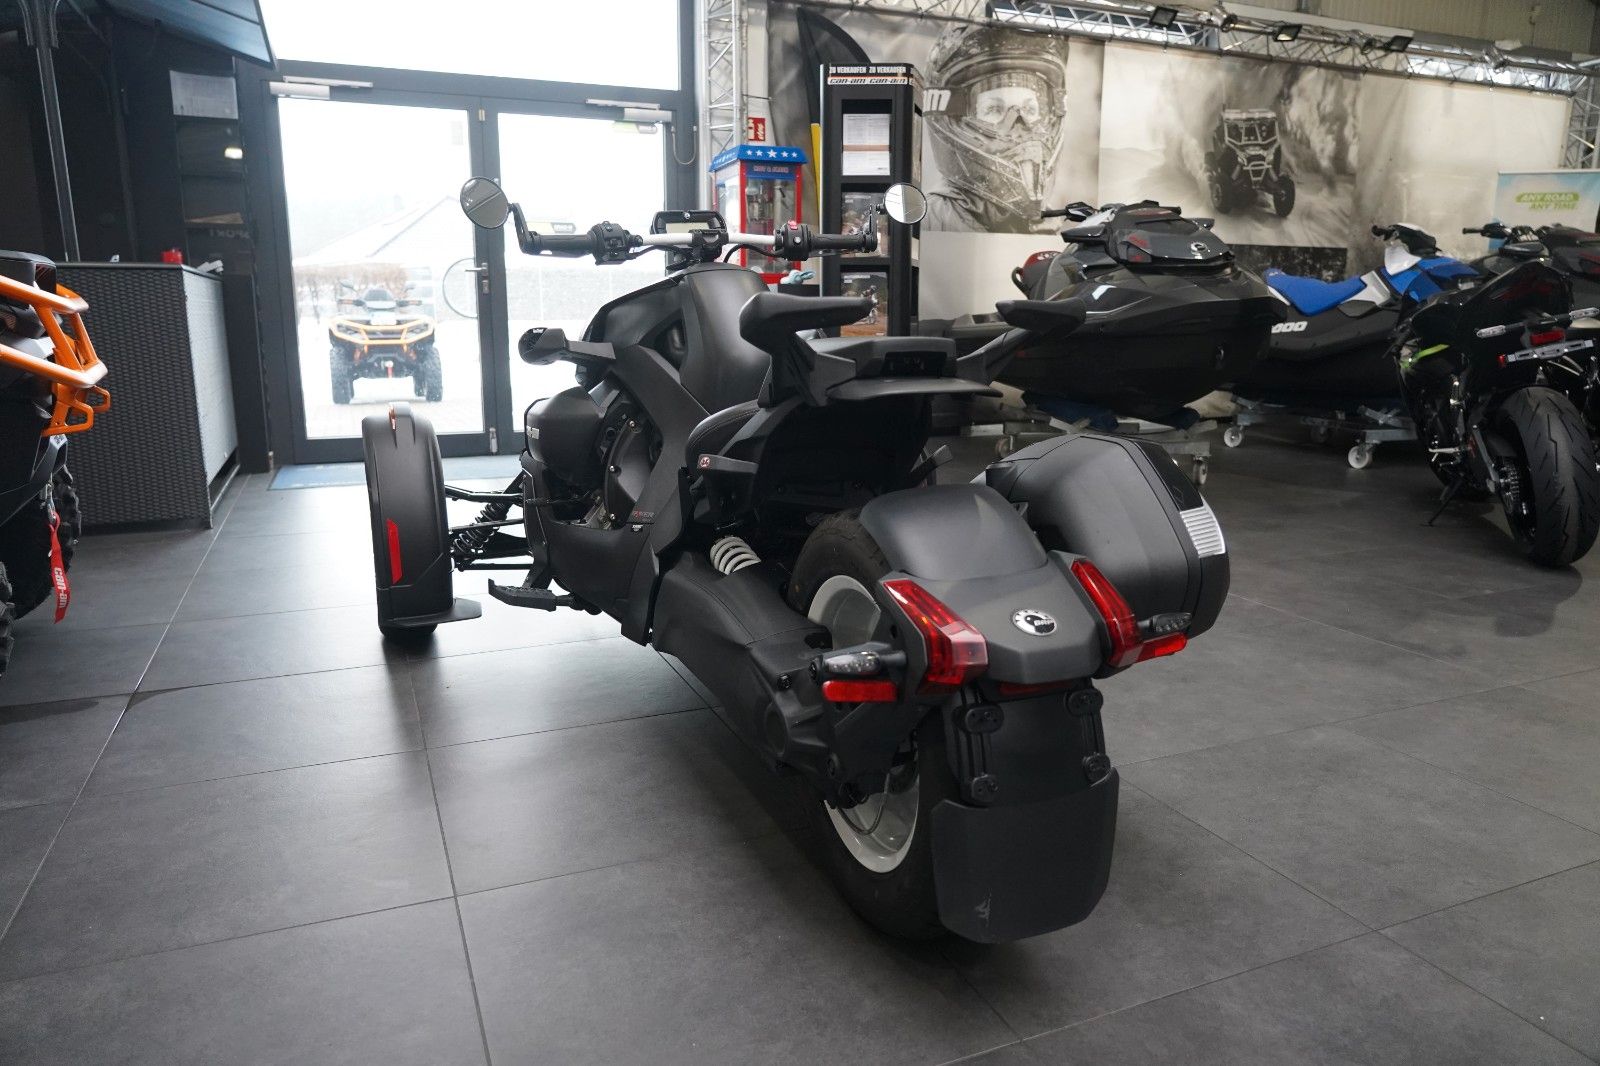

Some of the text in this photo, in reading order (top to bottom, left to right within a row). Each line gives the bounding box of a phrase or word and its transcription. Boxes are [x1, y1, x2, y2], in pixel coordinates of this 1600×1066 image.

[837, 66, 867, 74] VERKAUFEN
[876, 66, 907, 74] VERKAUFEN
[54, 567, 67, 608] can-am
